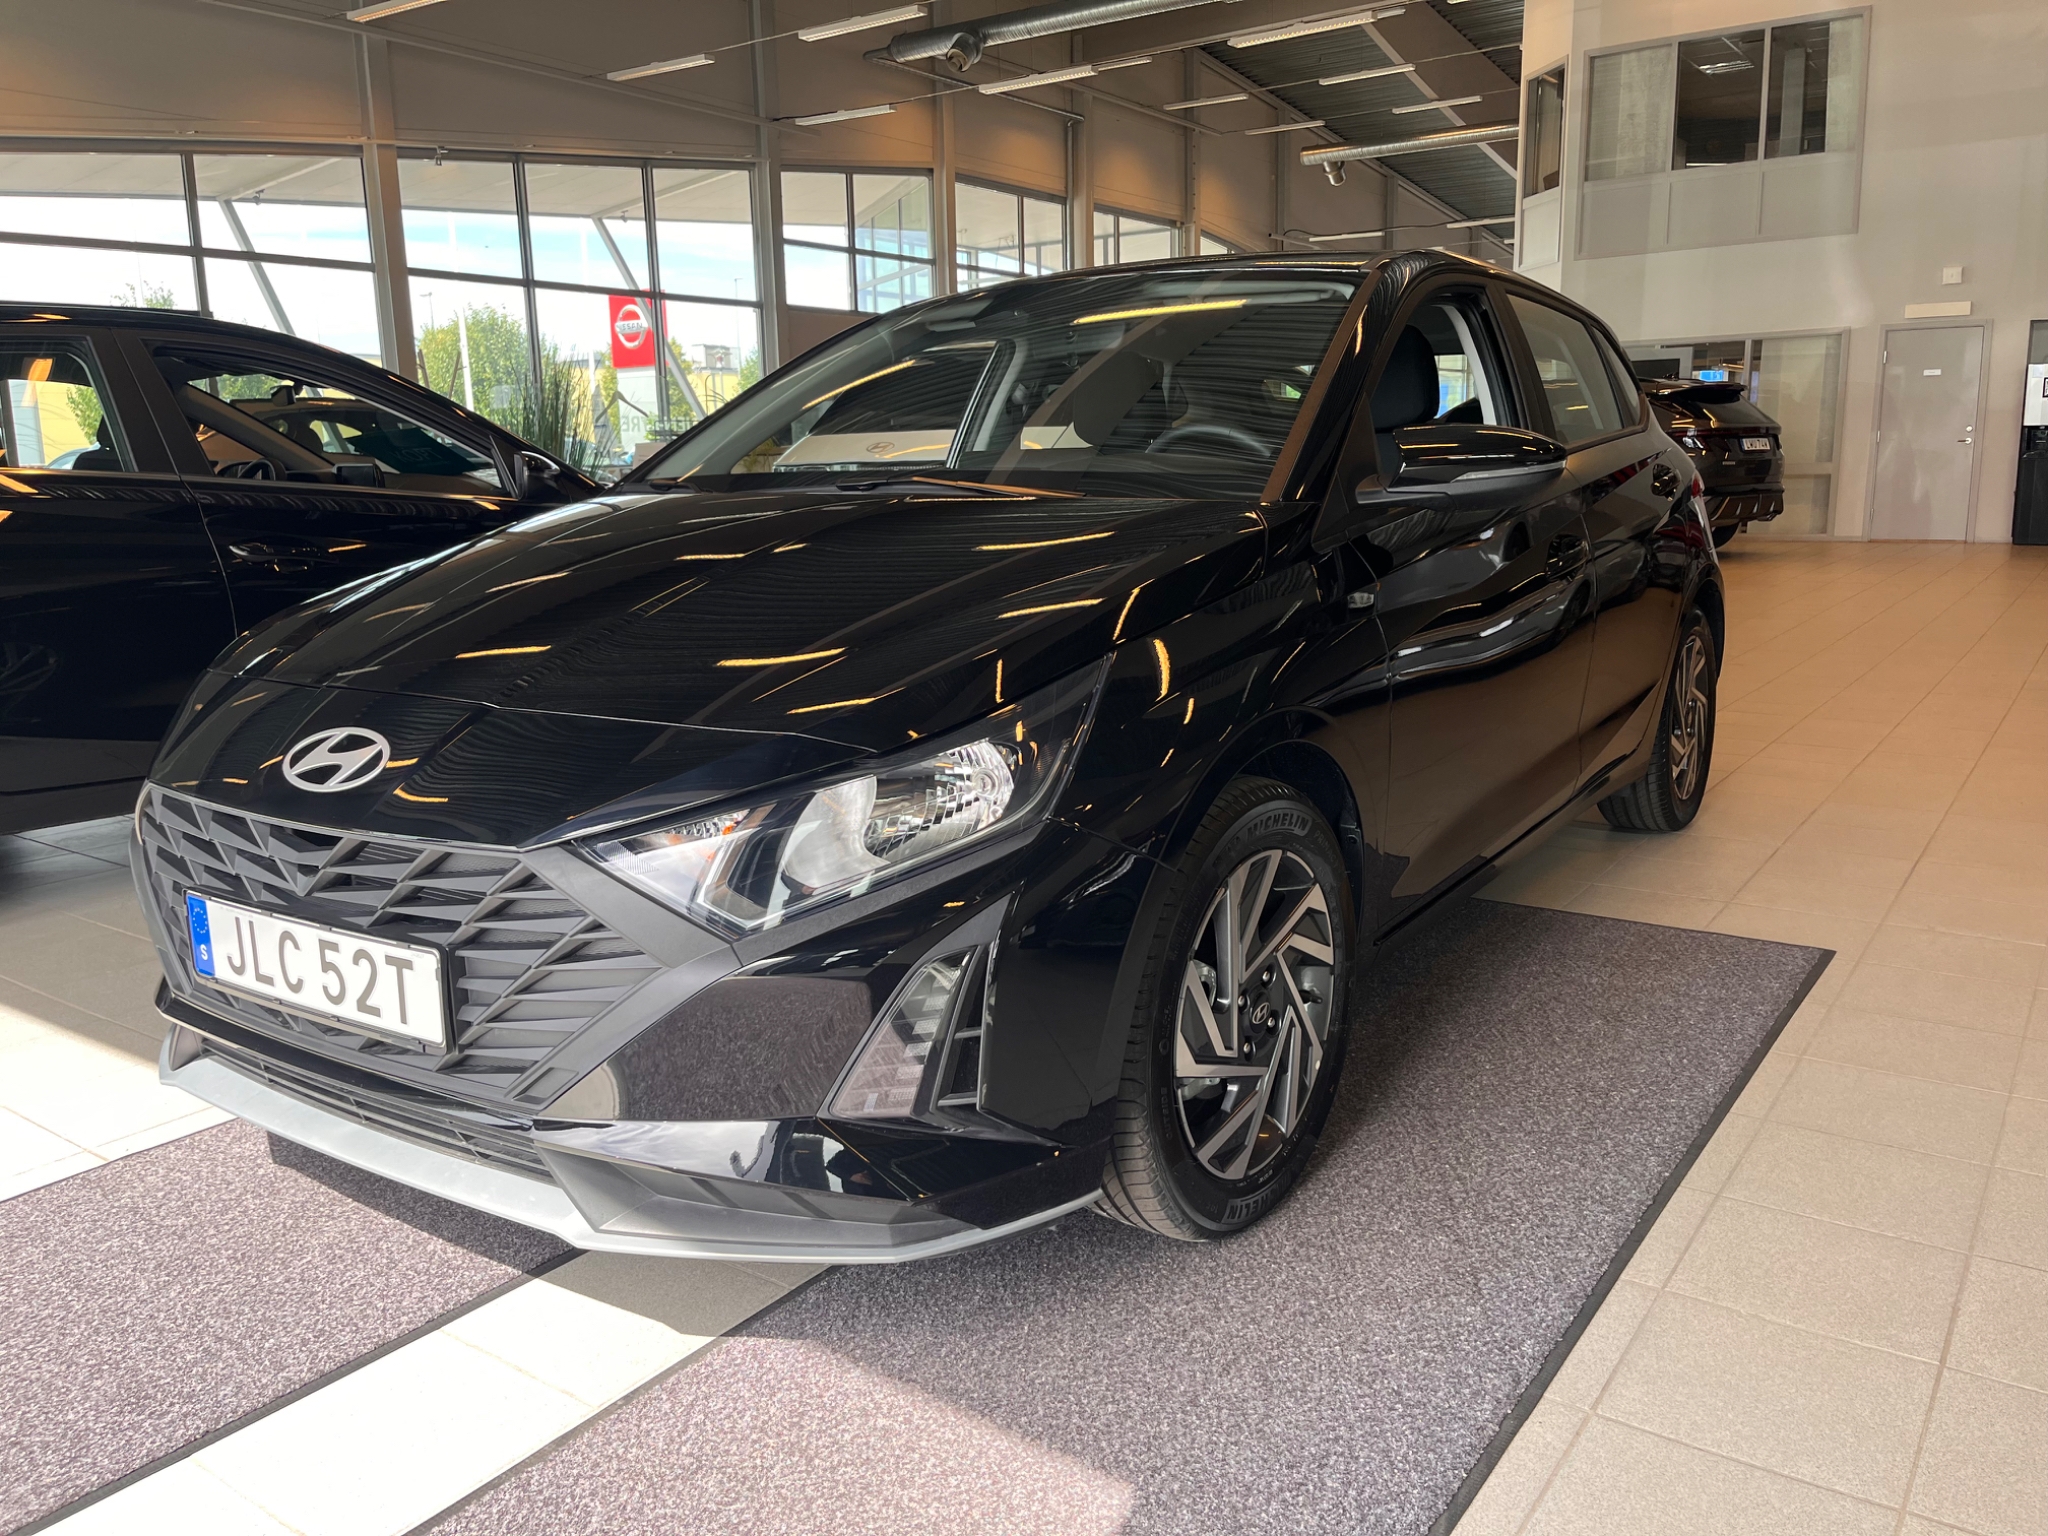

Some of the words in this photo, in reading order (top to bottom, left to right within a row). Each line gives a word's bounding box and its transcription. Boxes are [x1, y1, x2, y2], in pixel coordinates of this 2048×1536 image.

[1246, 813, 1310, 840] MICHELIN
[200, 944, 208, 960] S
[227, 917, 304, 994] JLC
[318, 938, 414, 1025] 52T
